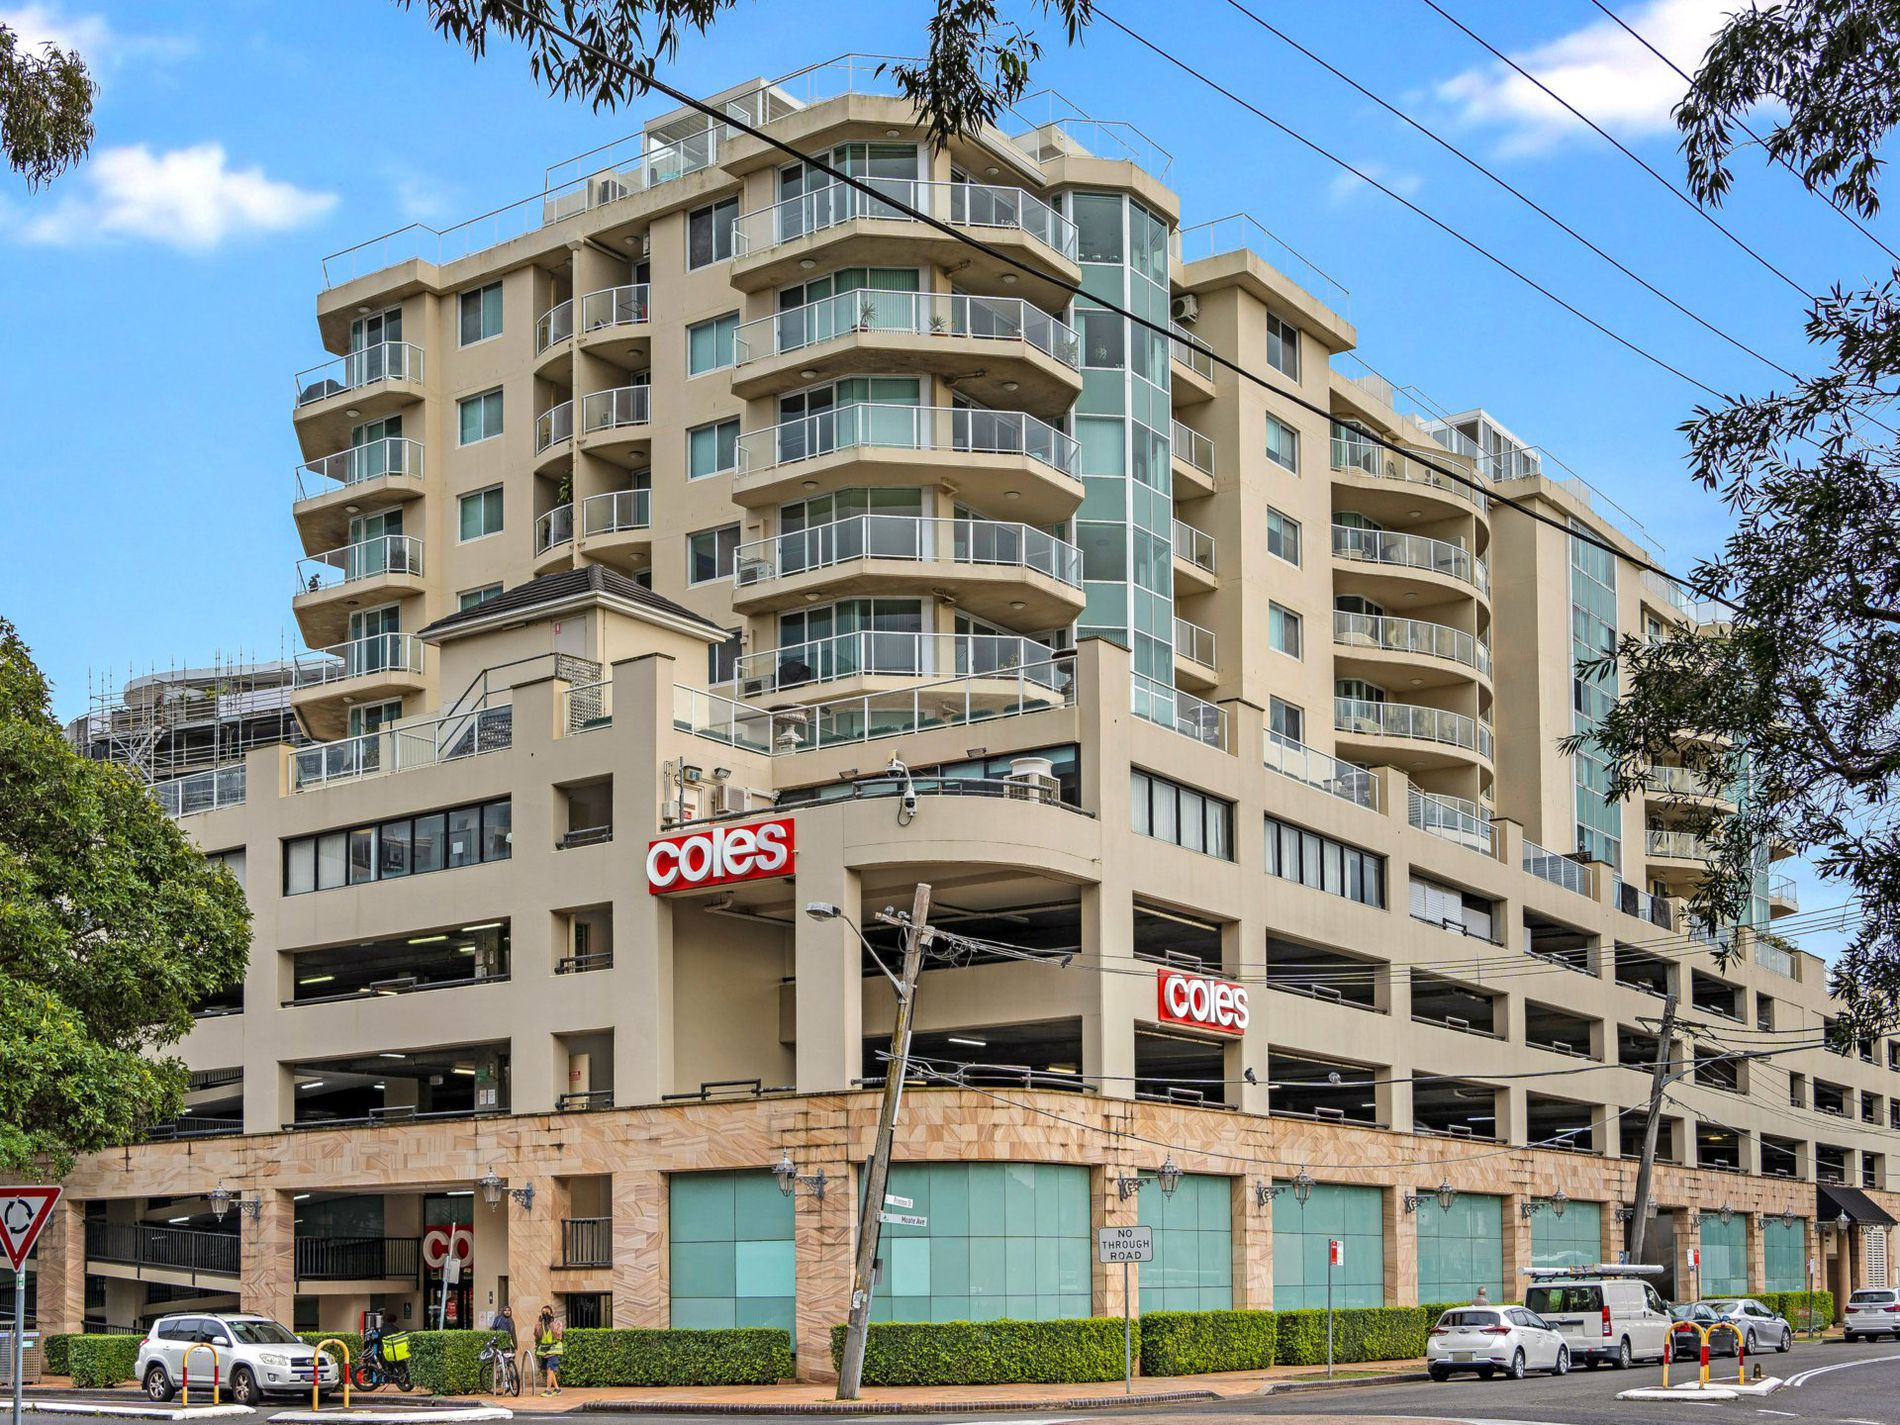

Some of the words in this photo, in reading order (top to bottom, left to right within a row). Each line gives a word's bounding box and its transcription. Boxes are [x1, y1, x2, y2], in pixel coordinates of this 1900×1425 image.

[646, 823, 788, 887] coles
[1164, 974, 1250, 1029] coles
[916, 1217, 925, 1225] Ave
[1117, 1229, 1133, 1238] NO
[1102, 1240, 1150, 1249] THROUGH
[1110, 1251, 1142, 1260] ROAD
